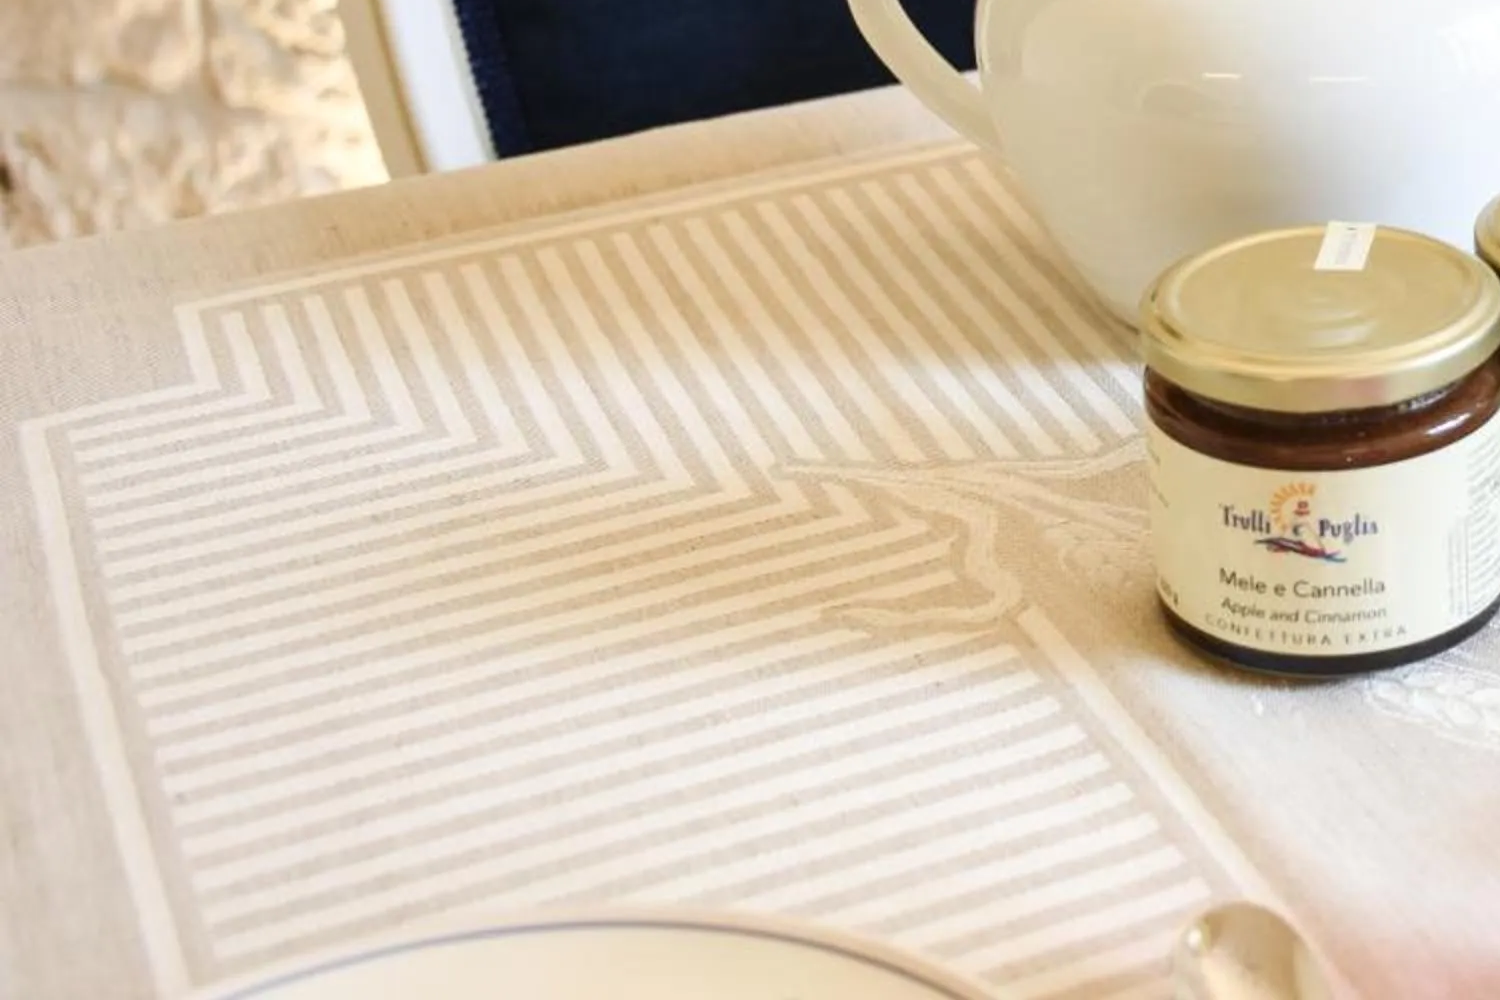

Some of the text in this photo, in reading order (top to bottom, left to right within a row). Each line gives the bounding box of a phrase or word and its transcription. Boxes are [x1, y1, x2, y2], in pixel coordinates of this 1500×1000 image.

[1218, 503, 1271, 534] Trulli
[1219, 567, 1386, 599] Mele e Cannella
[1221, 597, 1387, 624] Apple and Cinnamon
[1204, 613, 1332, 646] CONFETTURA
